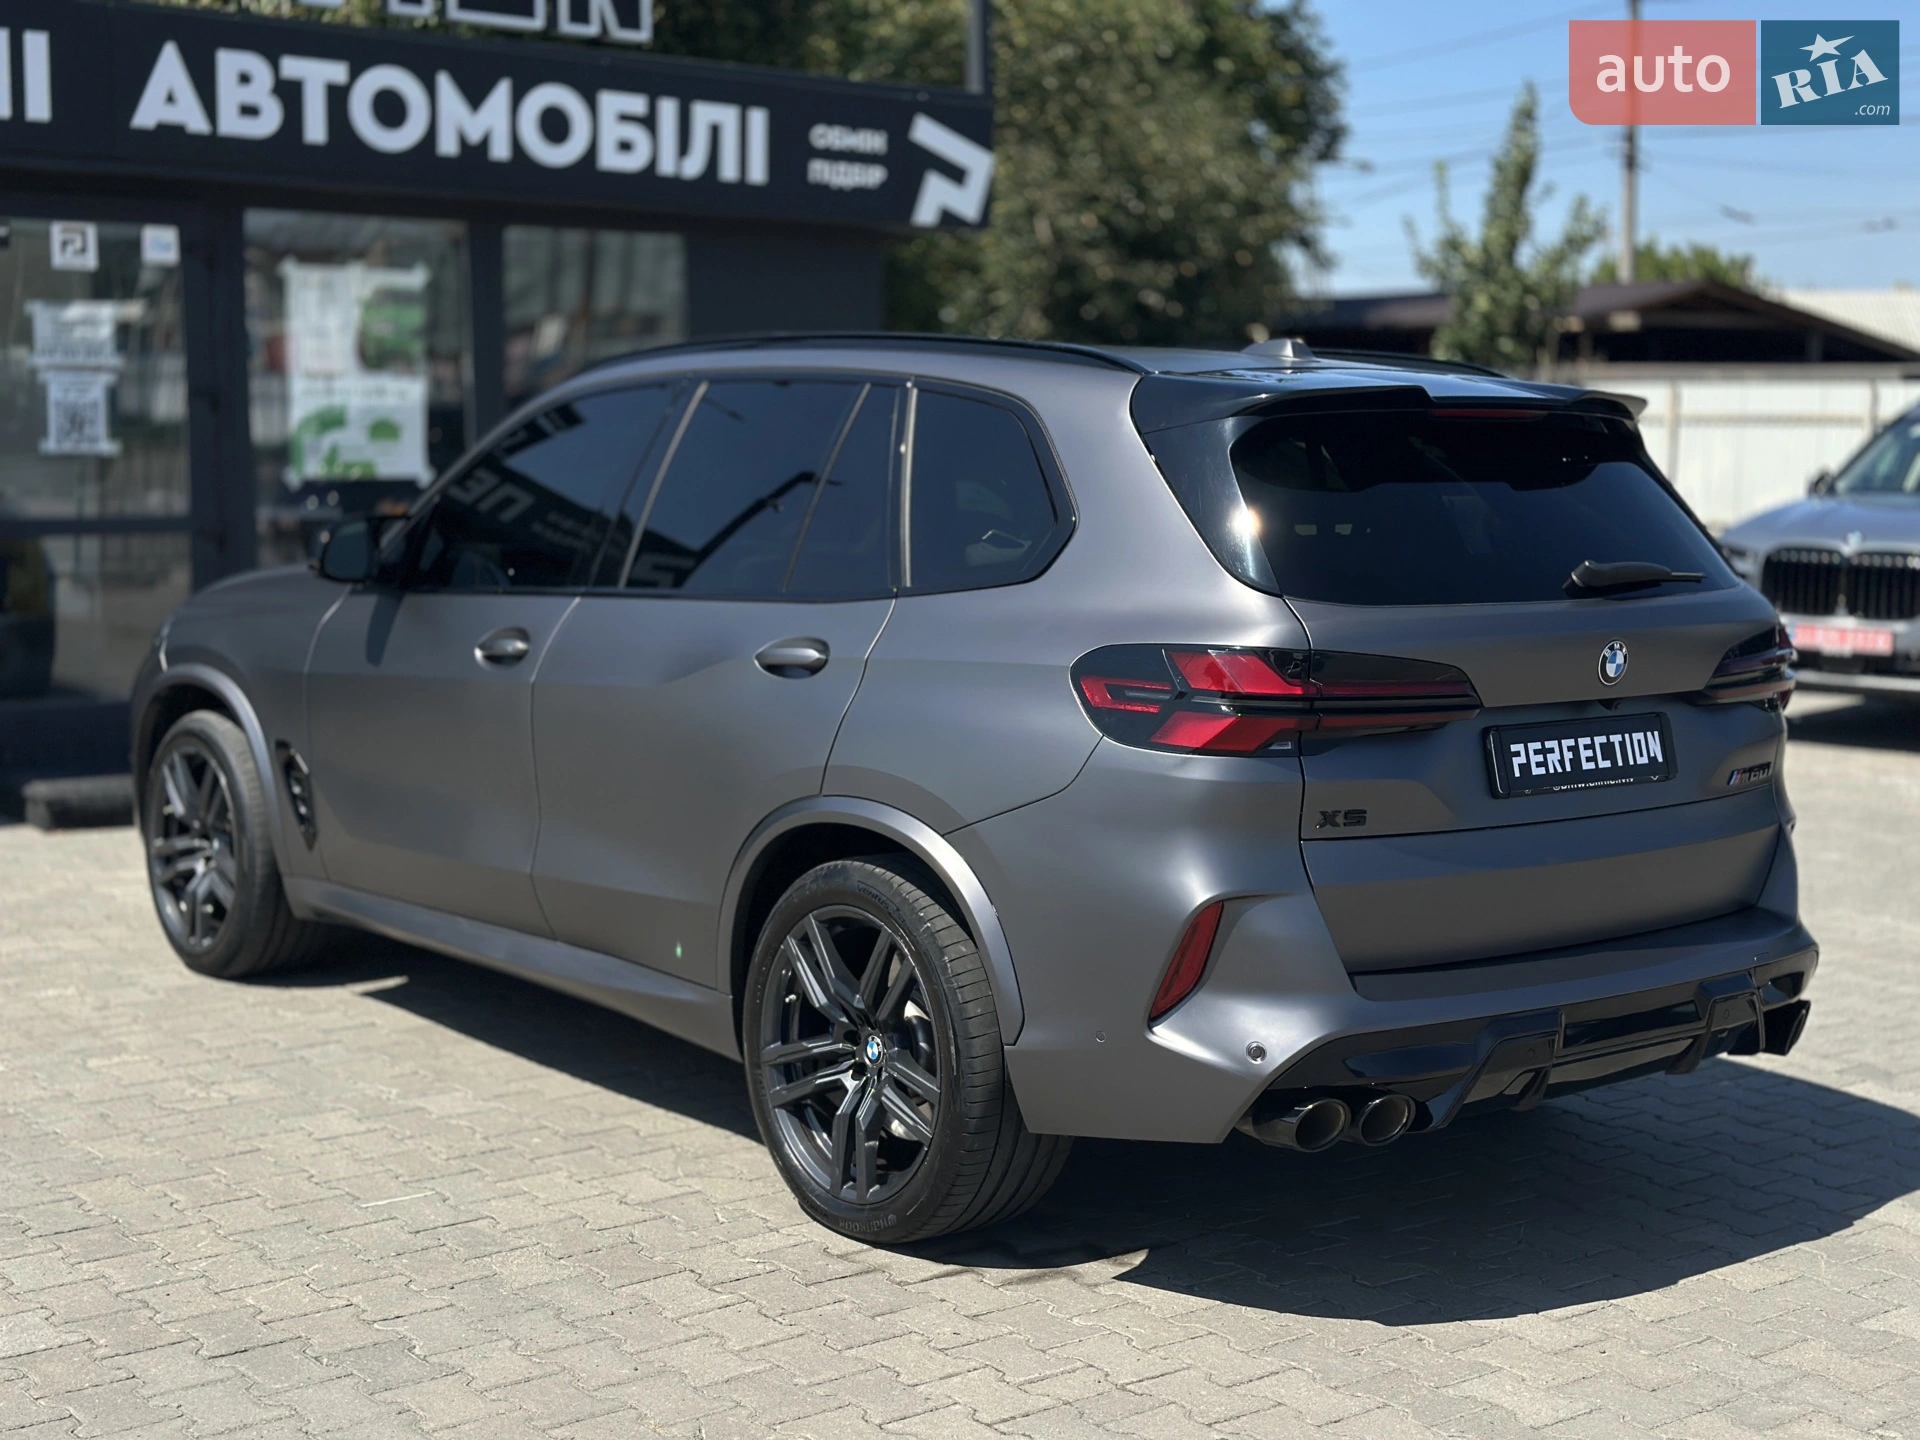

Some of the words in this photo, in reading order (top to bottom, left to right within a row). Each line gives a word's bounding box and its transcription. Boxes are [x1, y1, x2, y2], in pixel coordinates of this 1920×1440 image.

[129, 39, 769, 186] АВТОМОБІЛІ
[1510, 730, 1663, 778] PERFECTION
[1316, 808, 1367, 829] X5
